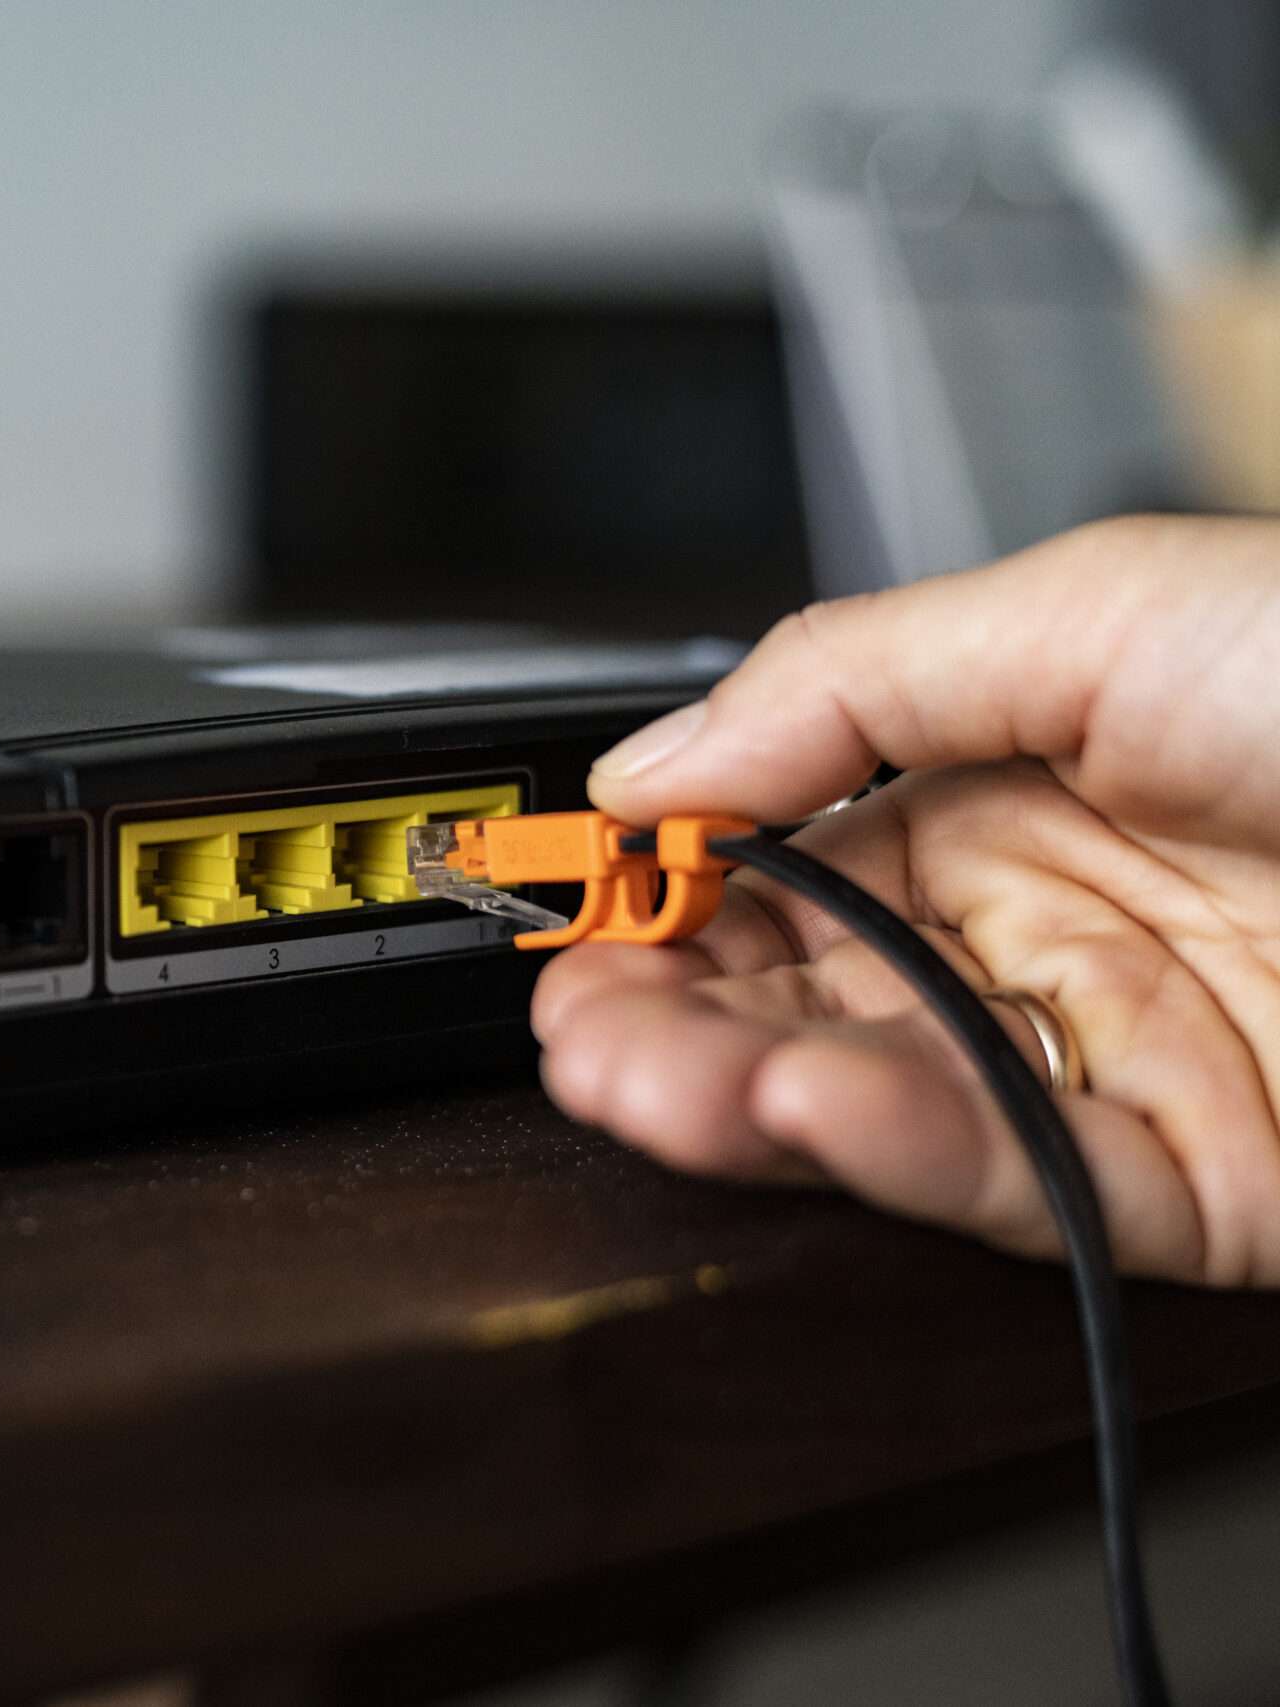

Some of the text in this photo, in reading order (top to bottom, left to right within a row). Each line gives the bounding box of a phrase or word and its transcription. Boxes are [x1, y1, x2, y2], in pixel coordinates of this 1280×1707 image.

[157, 963, 169, 983] 4
[268, 948, 280, 970] 3
[374, 934, 385, 956] 2
